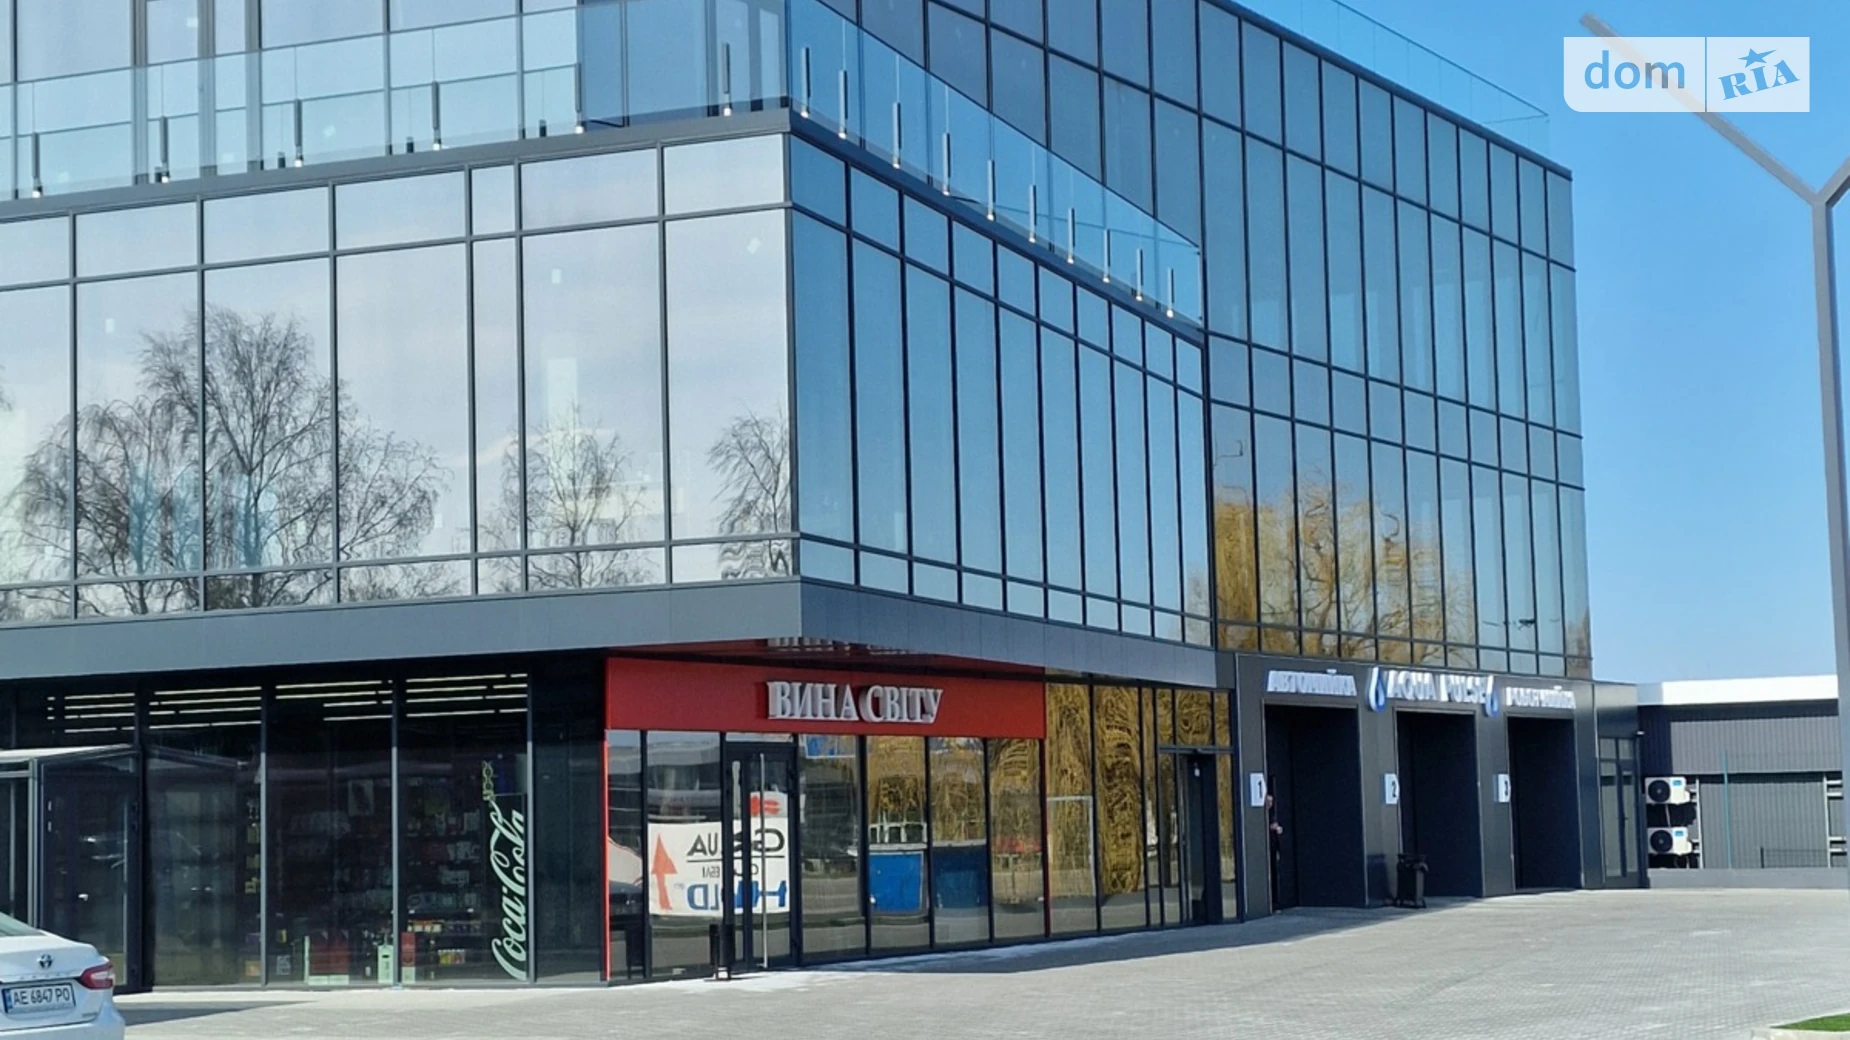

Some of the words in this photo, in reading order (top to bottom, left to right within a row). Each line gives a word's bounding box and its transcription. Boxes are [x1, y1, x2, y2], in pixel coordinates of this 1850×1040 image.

[766, 681, 859, 721] ВИНА
[859, 684, 944, 724] СВІТУ
[1387, 669, 1437, 700] AQUA
[1440, 674, 1486, 704] PULSE
[13, 990, 29, 1005] AE
[30, 988, 53, 1003] 6847
[55, 987, 70, 1002] PO
